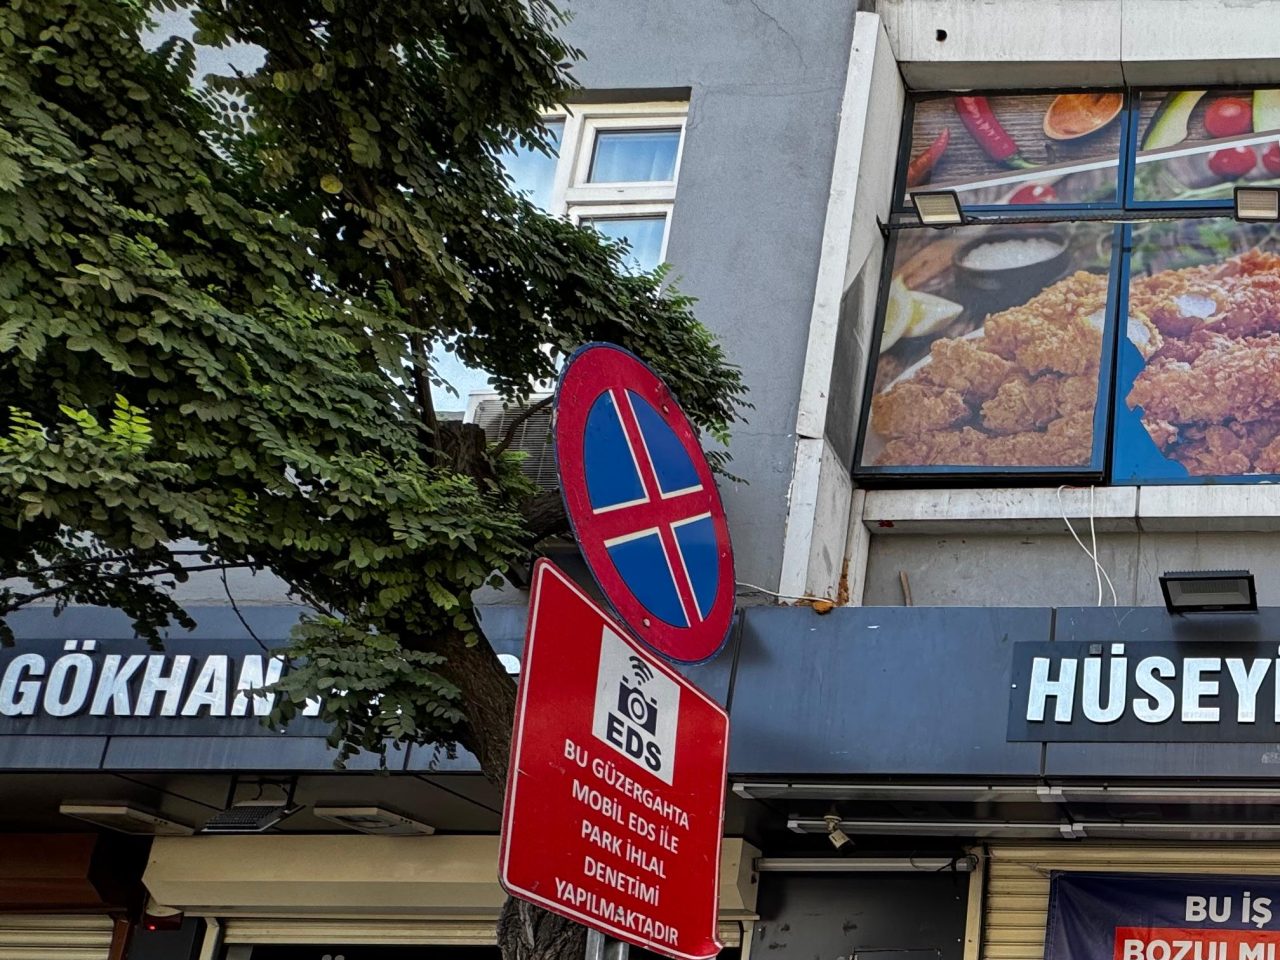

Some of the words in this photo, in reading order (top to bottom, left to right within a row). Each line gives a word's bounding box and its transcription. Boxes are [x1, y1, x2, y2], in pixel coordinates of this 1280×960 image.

[1, 639, 287, 717] GÖKHAN
[606, 712, 662, 772] EDS
[564, 738, 588, 768] BU
[592, 760, 690, 831] GÜZERGAHTA
[572, 778, 625, 825] MOBİL
[628, 812, 656, 842] EDS
[659, 825, 679, 854] İLE
[581, 819, 622, 857] PARK
[626, 838, 667, 879] İHLAL
[583, 855, 661, 907] DENETİMİ
[555, 876, 679, 946] YAPILMAKTADIR
[1185, 896, 1231, 923] BU
[1241, 891, 1272, 928] İŞ
